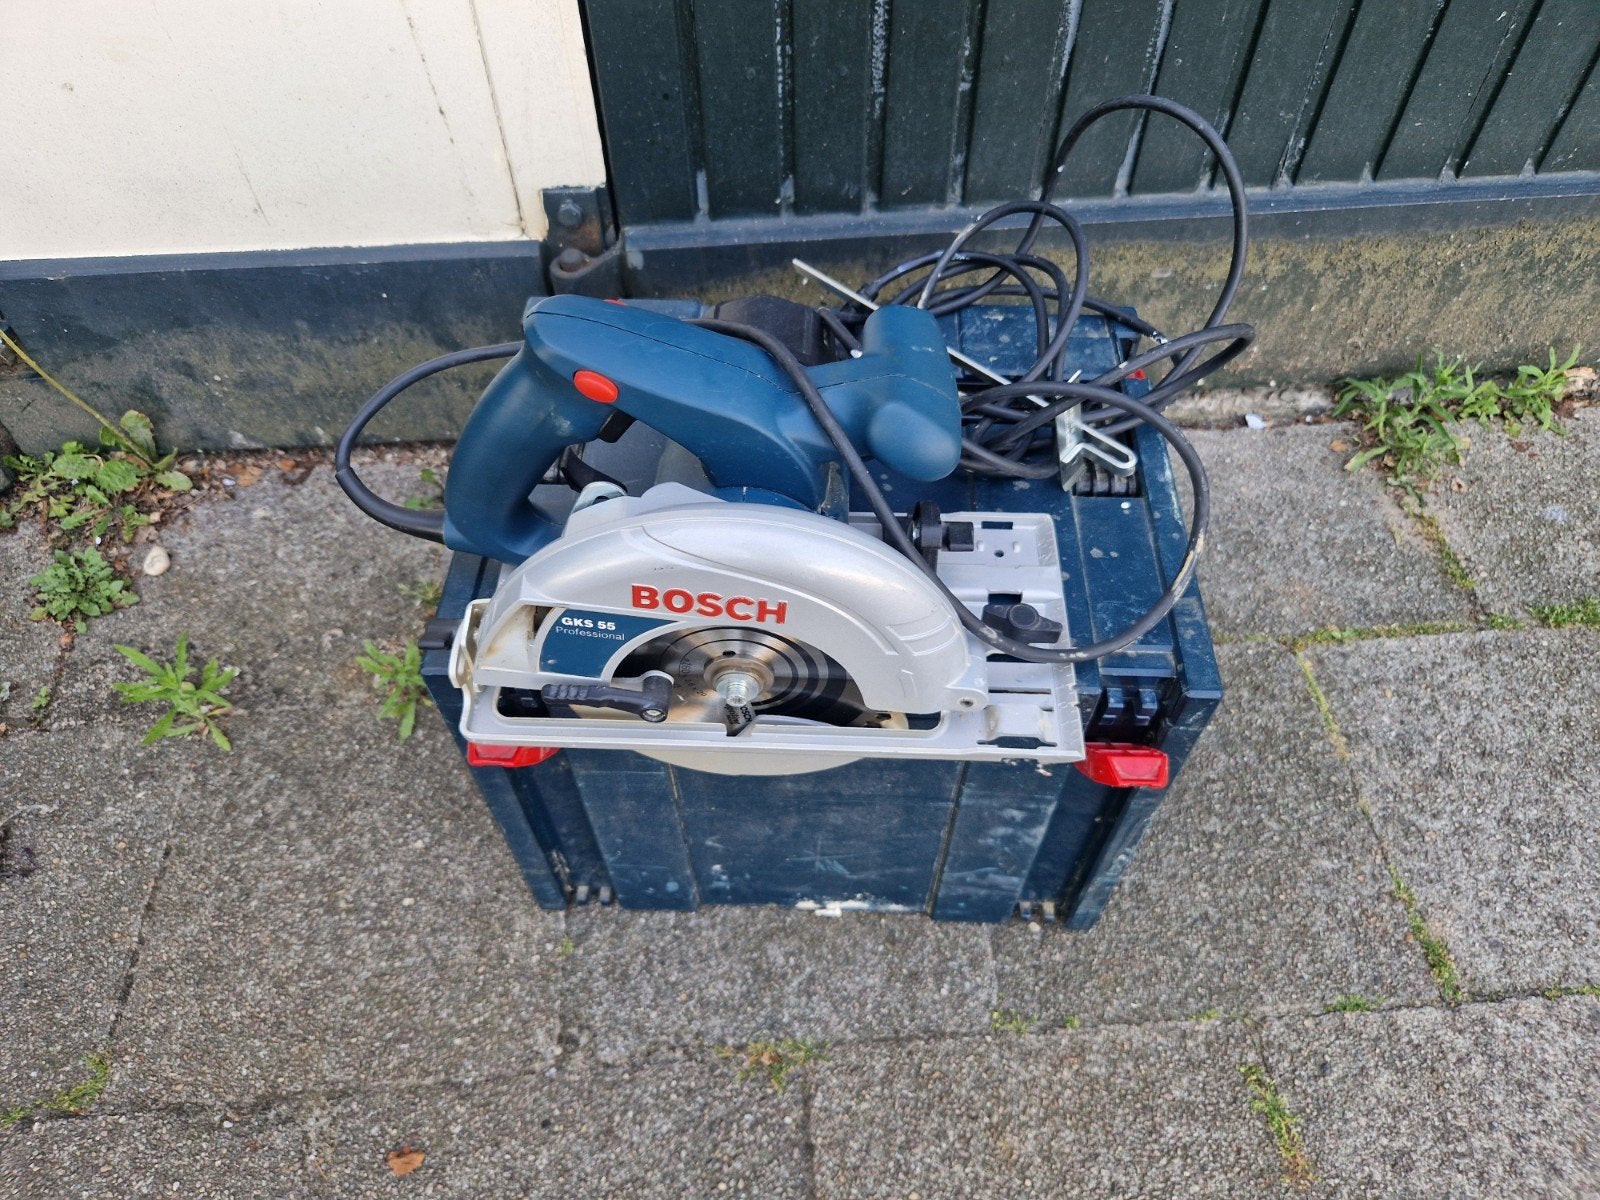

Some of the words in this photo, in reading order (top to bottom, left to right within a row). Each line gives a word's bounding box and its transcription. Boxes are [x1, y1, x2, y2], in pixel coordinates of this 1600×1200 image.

[631, 584, 788, 624] BOSCH
[561, 617, 594, 628] GKS
[597, 621, 616, 631] 55
[555, 626, 625, 641] Professional
